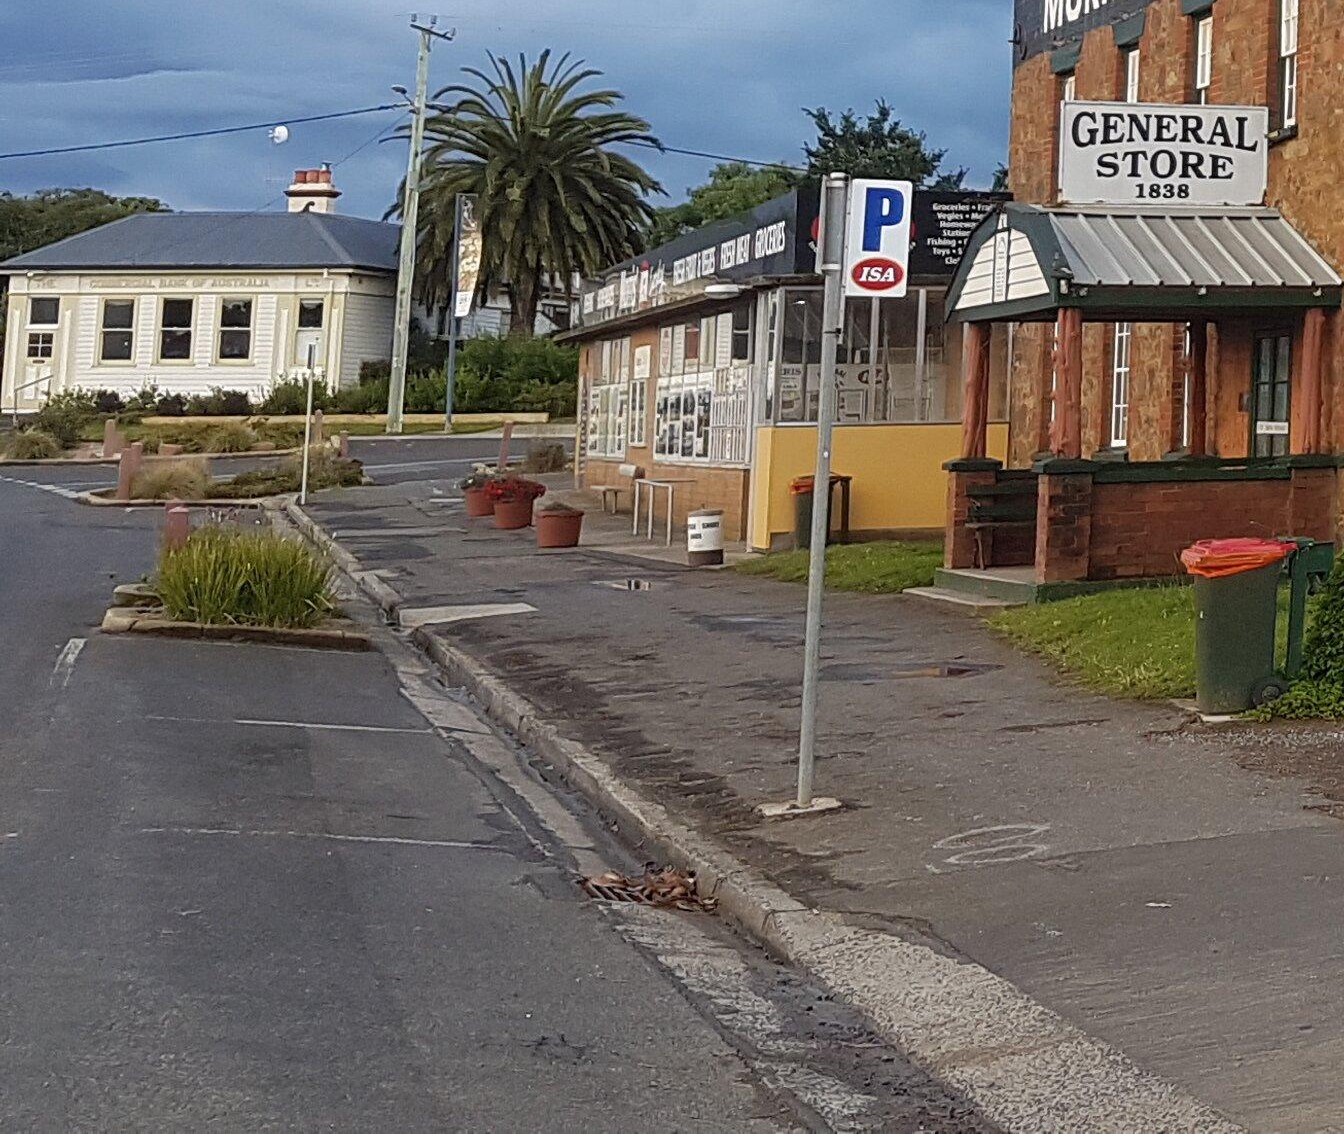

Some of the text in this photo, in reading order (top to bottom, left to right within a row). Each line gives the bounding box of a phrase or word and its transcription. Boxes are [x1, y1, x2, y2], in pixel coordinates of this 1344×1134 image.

[1071, 111, 1259, 152] GENERAL
[1096, 149, 1235, 180] STORE
[1135, 183, 1190, 199] 1838
[932, 202, 970, 211] Groceries
[861, 186, 905, 253] P
[858, 266, 895, 283] ISA
